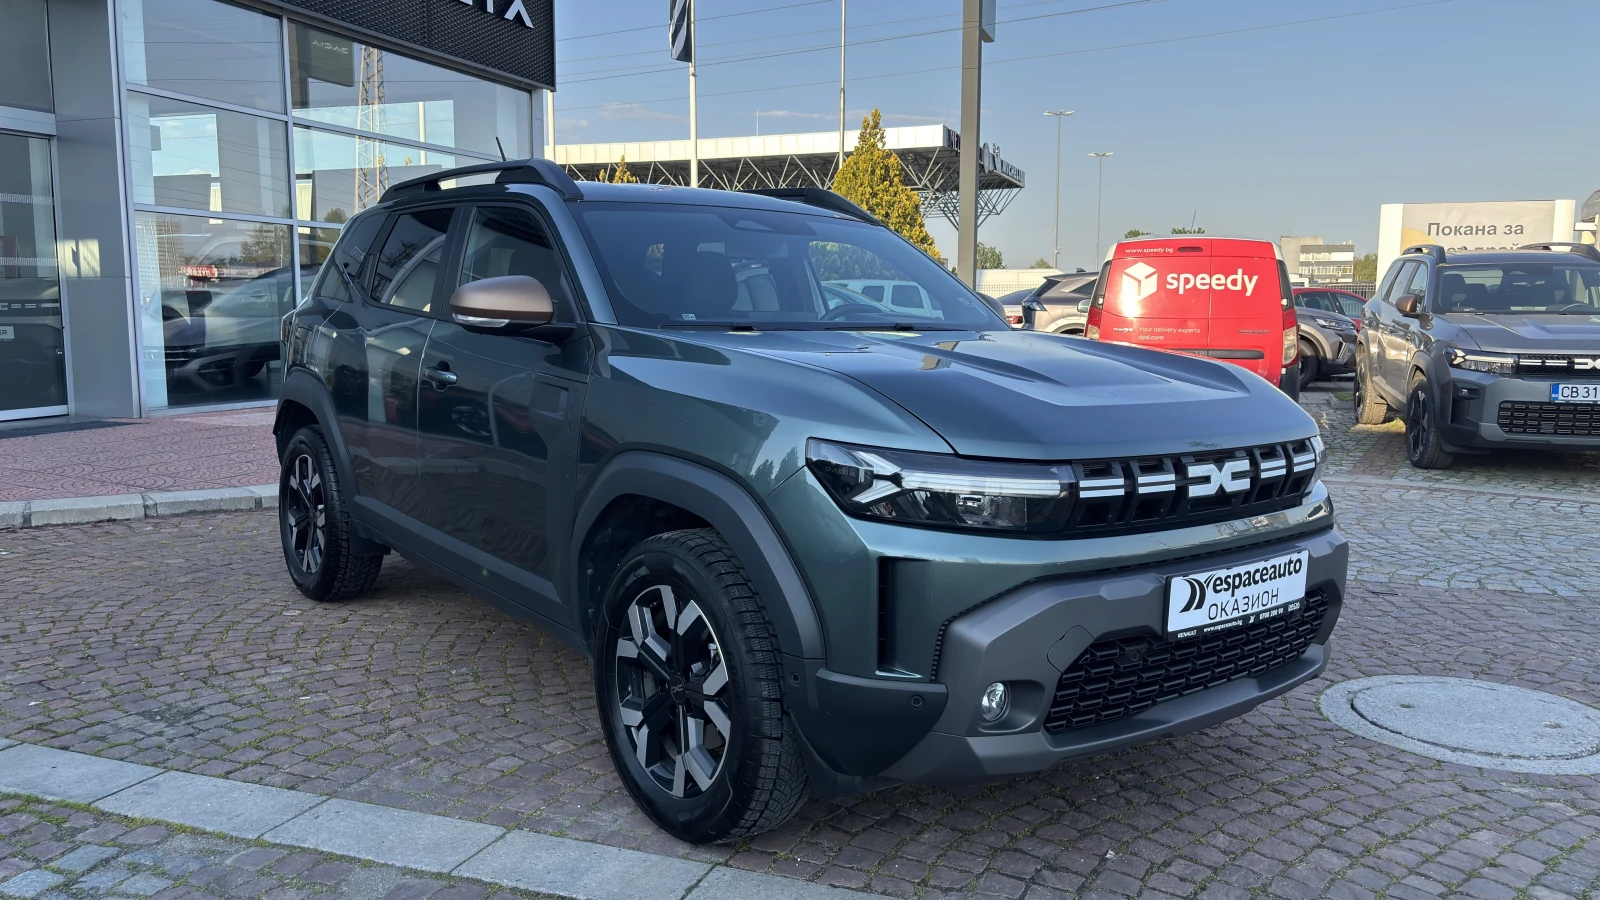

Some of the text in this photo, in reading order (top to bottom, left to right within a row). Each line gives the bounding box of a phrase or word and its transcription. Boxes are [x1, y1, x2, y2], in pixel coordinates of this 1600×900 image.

[1427, 222, 1524, 236] Покана за
[1166, 268, 1259, 297] speedy
[1561, 386, 1579, 399] CB
[1212, 556, 1302, 597] espaceauto
[1208, 587, 1279, 620] ОКАЗИОН
[1177, 629, 1198, 638] RENAULT
[1203, 619, 1243, 632] www.espaceauto.bg
